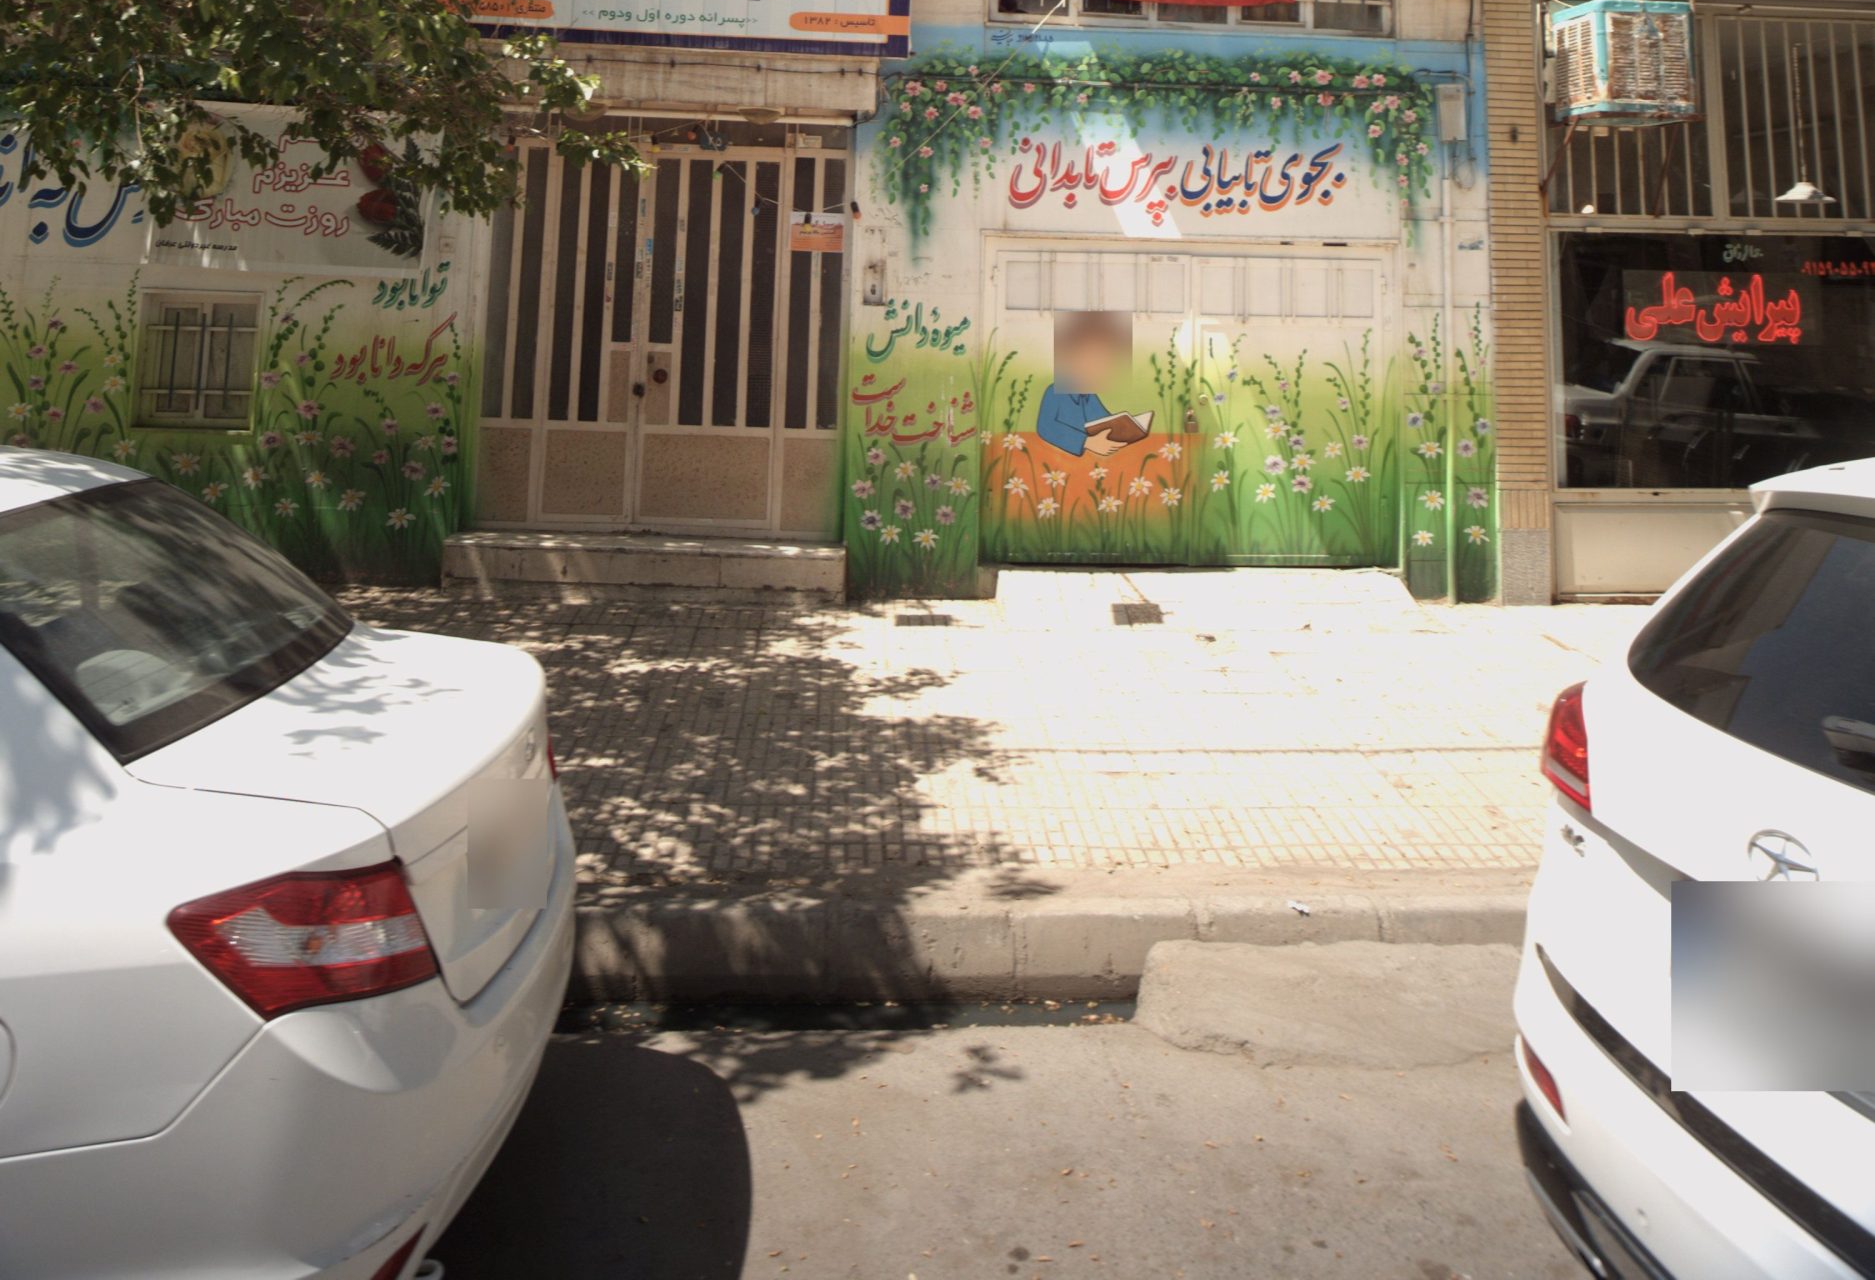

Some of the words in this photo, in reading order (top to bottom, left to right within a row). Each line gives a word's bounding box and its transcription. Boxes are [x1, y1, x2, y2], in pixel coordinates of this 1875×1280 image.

[664, 12, 696, 24] دوره
[1008, 136, 1083, 210] بدانی
[1083, 141, 1117, 191] تا
[1179, 143, 1252, 218] بیابی
[1257, 142, 1347, 212] بجوی
[264, 204, 350, 237] روزت
[371, 278, 409, 311] بود
[1625, 271, 1696, 342] علی
[1695, 273, 1803, 345] پیرایش
[866, 298, 929, 364] دانش
[328, 345, 368, 386] بود
